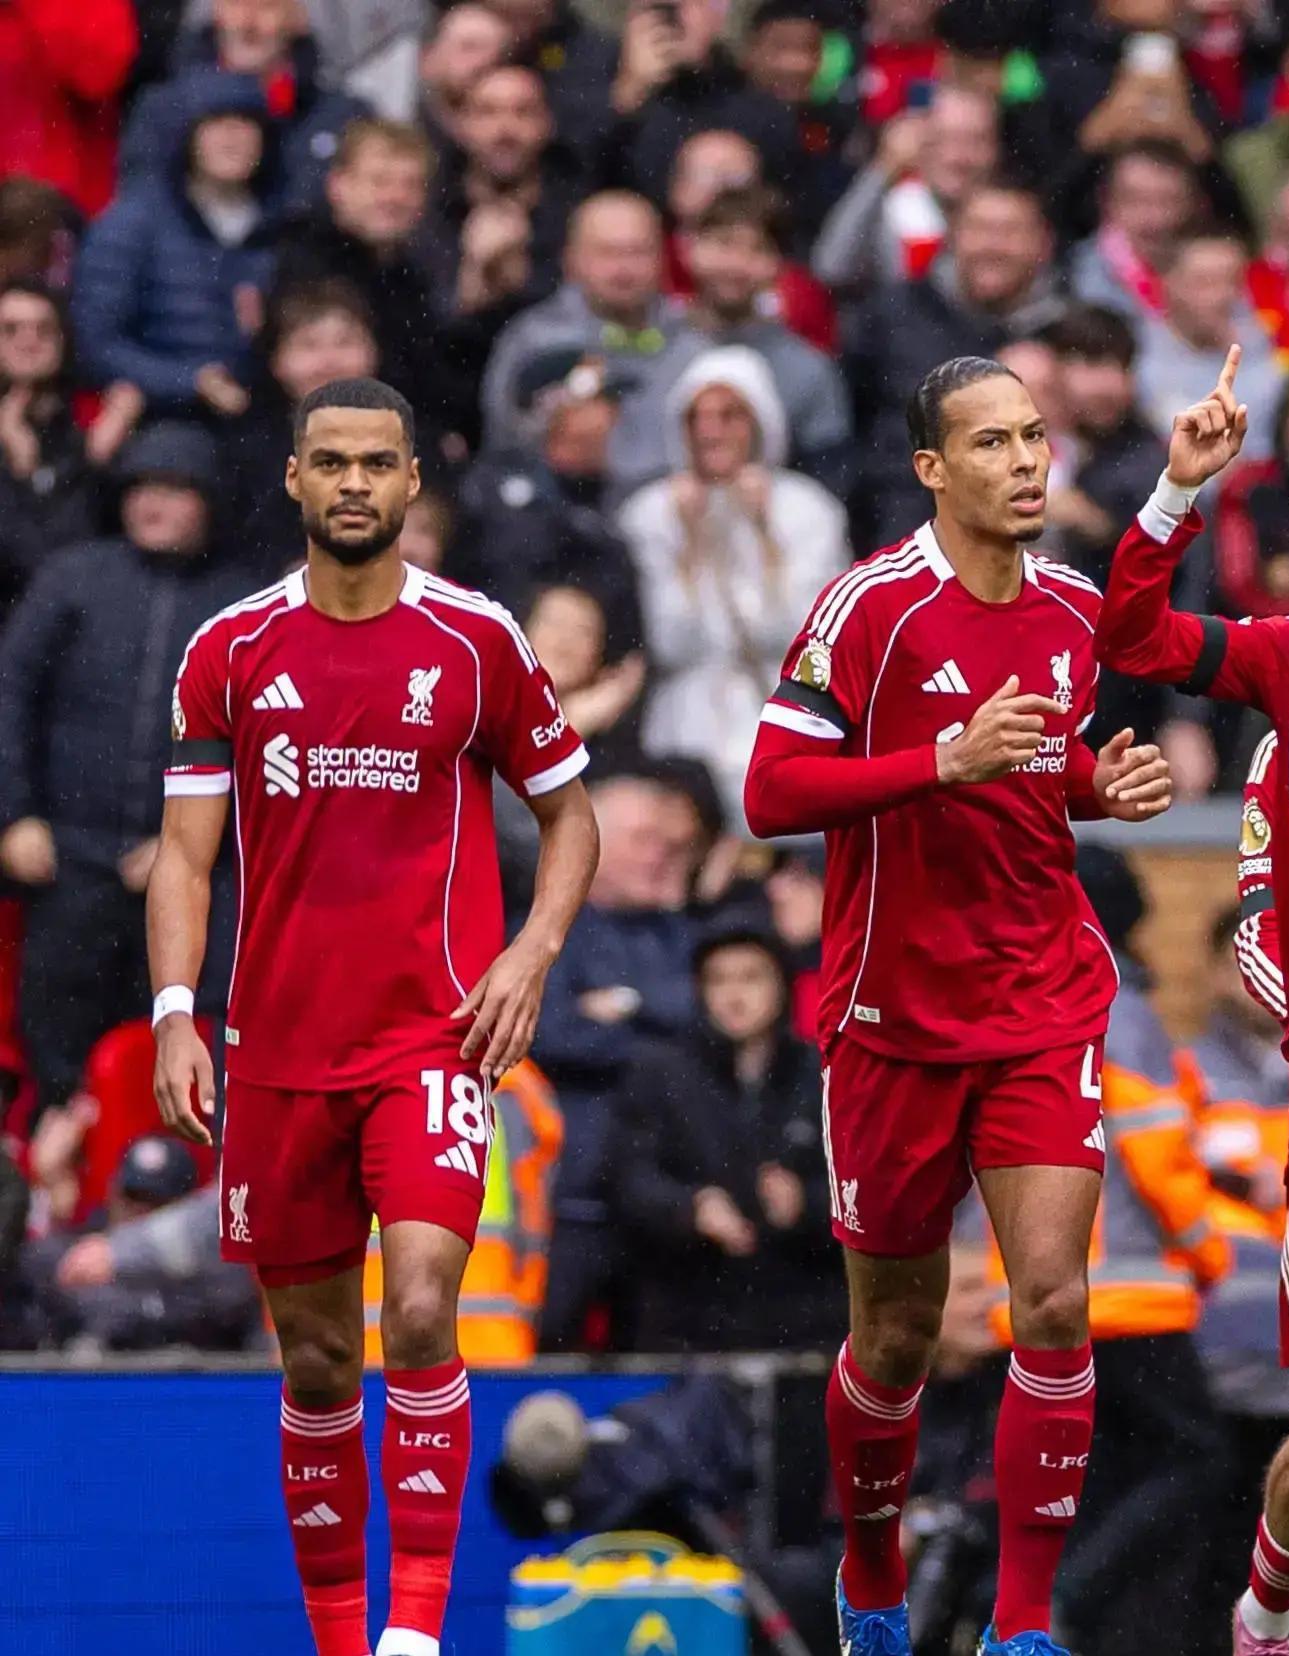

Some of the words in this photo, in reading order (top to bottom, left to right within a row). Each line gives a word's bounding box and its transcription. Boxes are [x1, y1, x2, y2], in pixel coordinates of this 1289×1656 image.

[531, 714, 568, 749] Exp
[307, 743, 419, 771] standard
[308, 765, 420, 793] chartered
[421, 1069, 486, 1144] 18
[399, 1431, 451, 1448] LFC
[287, 1464, 338, 1481] LFC
[1040, 1452, 1089, 1470] LFC
[853, 1471, 906, 1490] LFC
